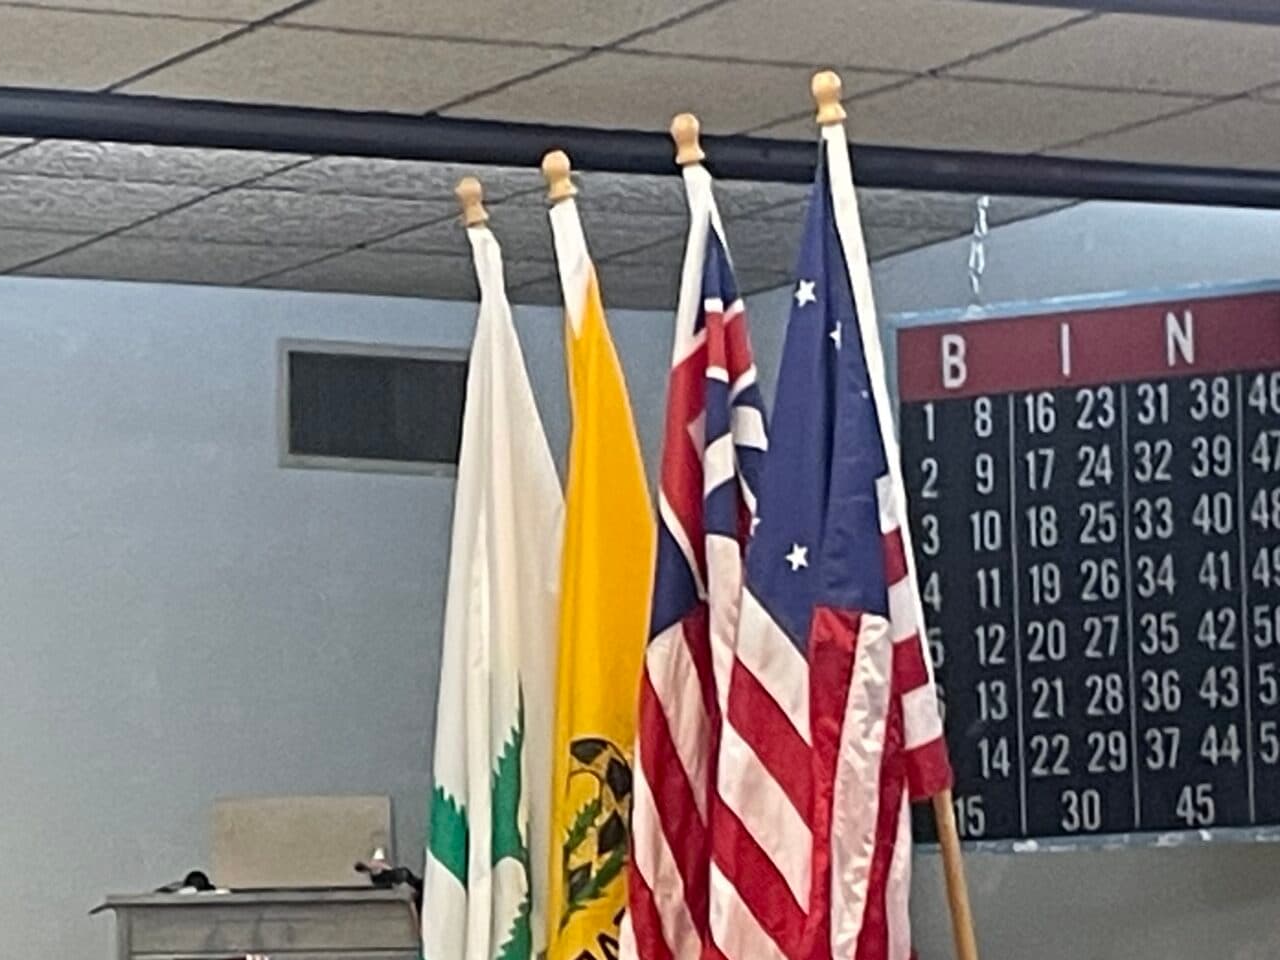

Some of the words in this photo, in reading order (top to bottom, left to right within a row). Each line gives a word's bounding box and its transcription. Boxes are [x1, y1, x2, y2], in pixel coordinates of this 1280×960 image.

[942, 334, 967, 388] B
[1061, 323, 1071, 376] I
[1166, 310, 1194, 366] N
[924, 402, 934, 441] 1
[974, 396, 993, 437] 8
[1025, 391, 1056, 433] 16
[1076, 386, 1115, 430] 23
[1137, 383, 1169, 425] 31
[1189, 376, 1230, 421] 38
[921, 457, 938, 498] 2
[975, 453, 994, 494] 9
[1025, 448, 1055, 490] 17
[1078, 444, 1113, 487] 24
[1134, 439, 1173, 483] 32
[1191, 434, 1232, 478] 39
[922, 514, 940, 555] 3
[970, 509, 1002, 551] 10
[1027, 505, 1058, 547] 18
[1079, 501, 1117, 544] 25
[1134, 497, 1174, 540] 33
[1192, 492, 1232, 534] 40
[923, 571, 941, 611] 4
[977, 567, 1001, 609] 11
[1029, 562, 1061, 605] 19
[1080, 558, 1120, 601] 26
[1137, 553, 1175, 597] 34
[1199, 550, 1231, 591] 41
[975, 624, 1006, 665] 12
[1027, 619, 1066, 662] 20
[1083, 615, 1120, 658] 27
[1140, 612, 1179, 655] 35
[1197, 607, 1236, 650] 42
[977, 680, 1008, 721] 13
[1031, 677, 1064, 719] 21
[1085, 673, 1124, 716] 28
[1142, 669, 1181, 712] 36
[1199, 665, 1239, 708] 43
[978, 737, 1011, 779] 14
[1030, 733, 1070, 776] 22
[1087, 730, 1127, 773] 29
[1145, 727, 1180, 770] 37
[1200, 724, 1241, 765] 44
[955, 795, 985, 836] 15
[1061, 789, 1101, 831] 30
[1176, 783, 1215, 826] 45
